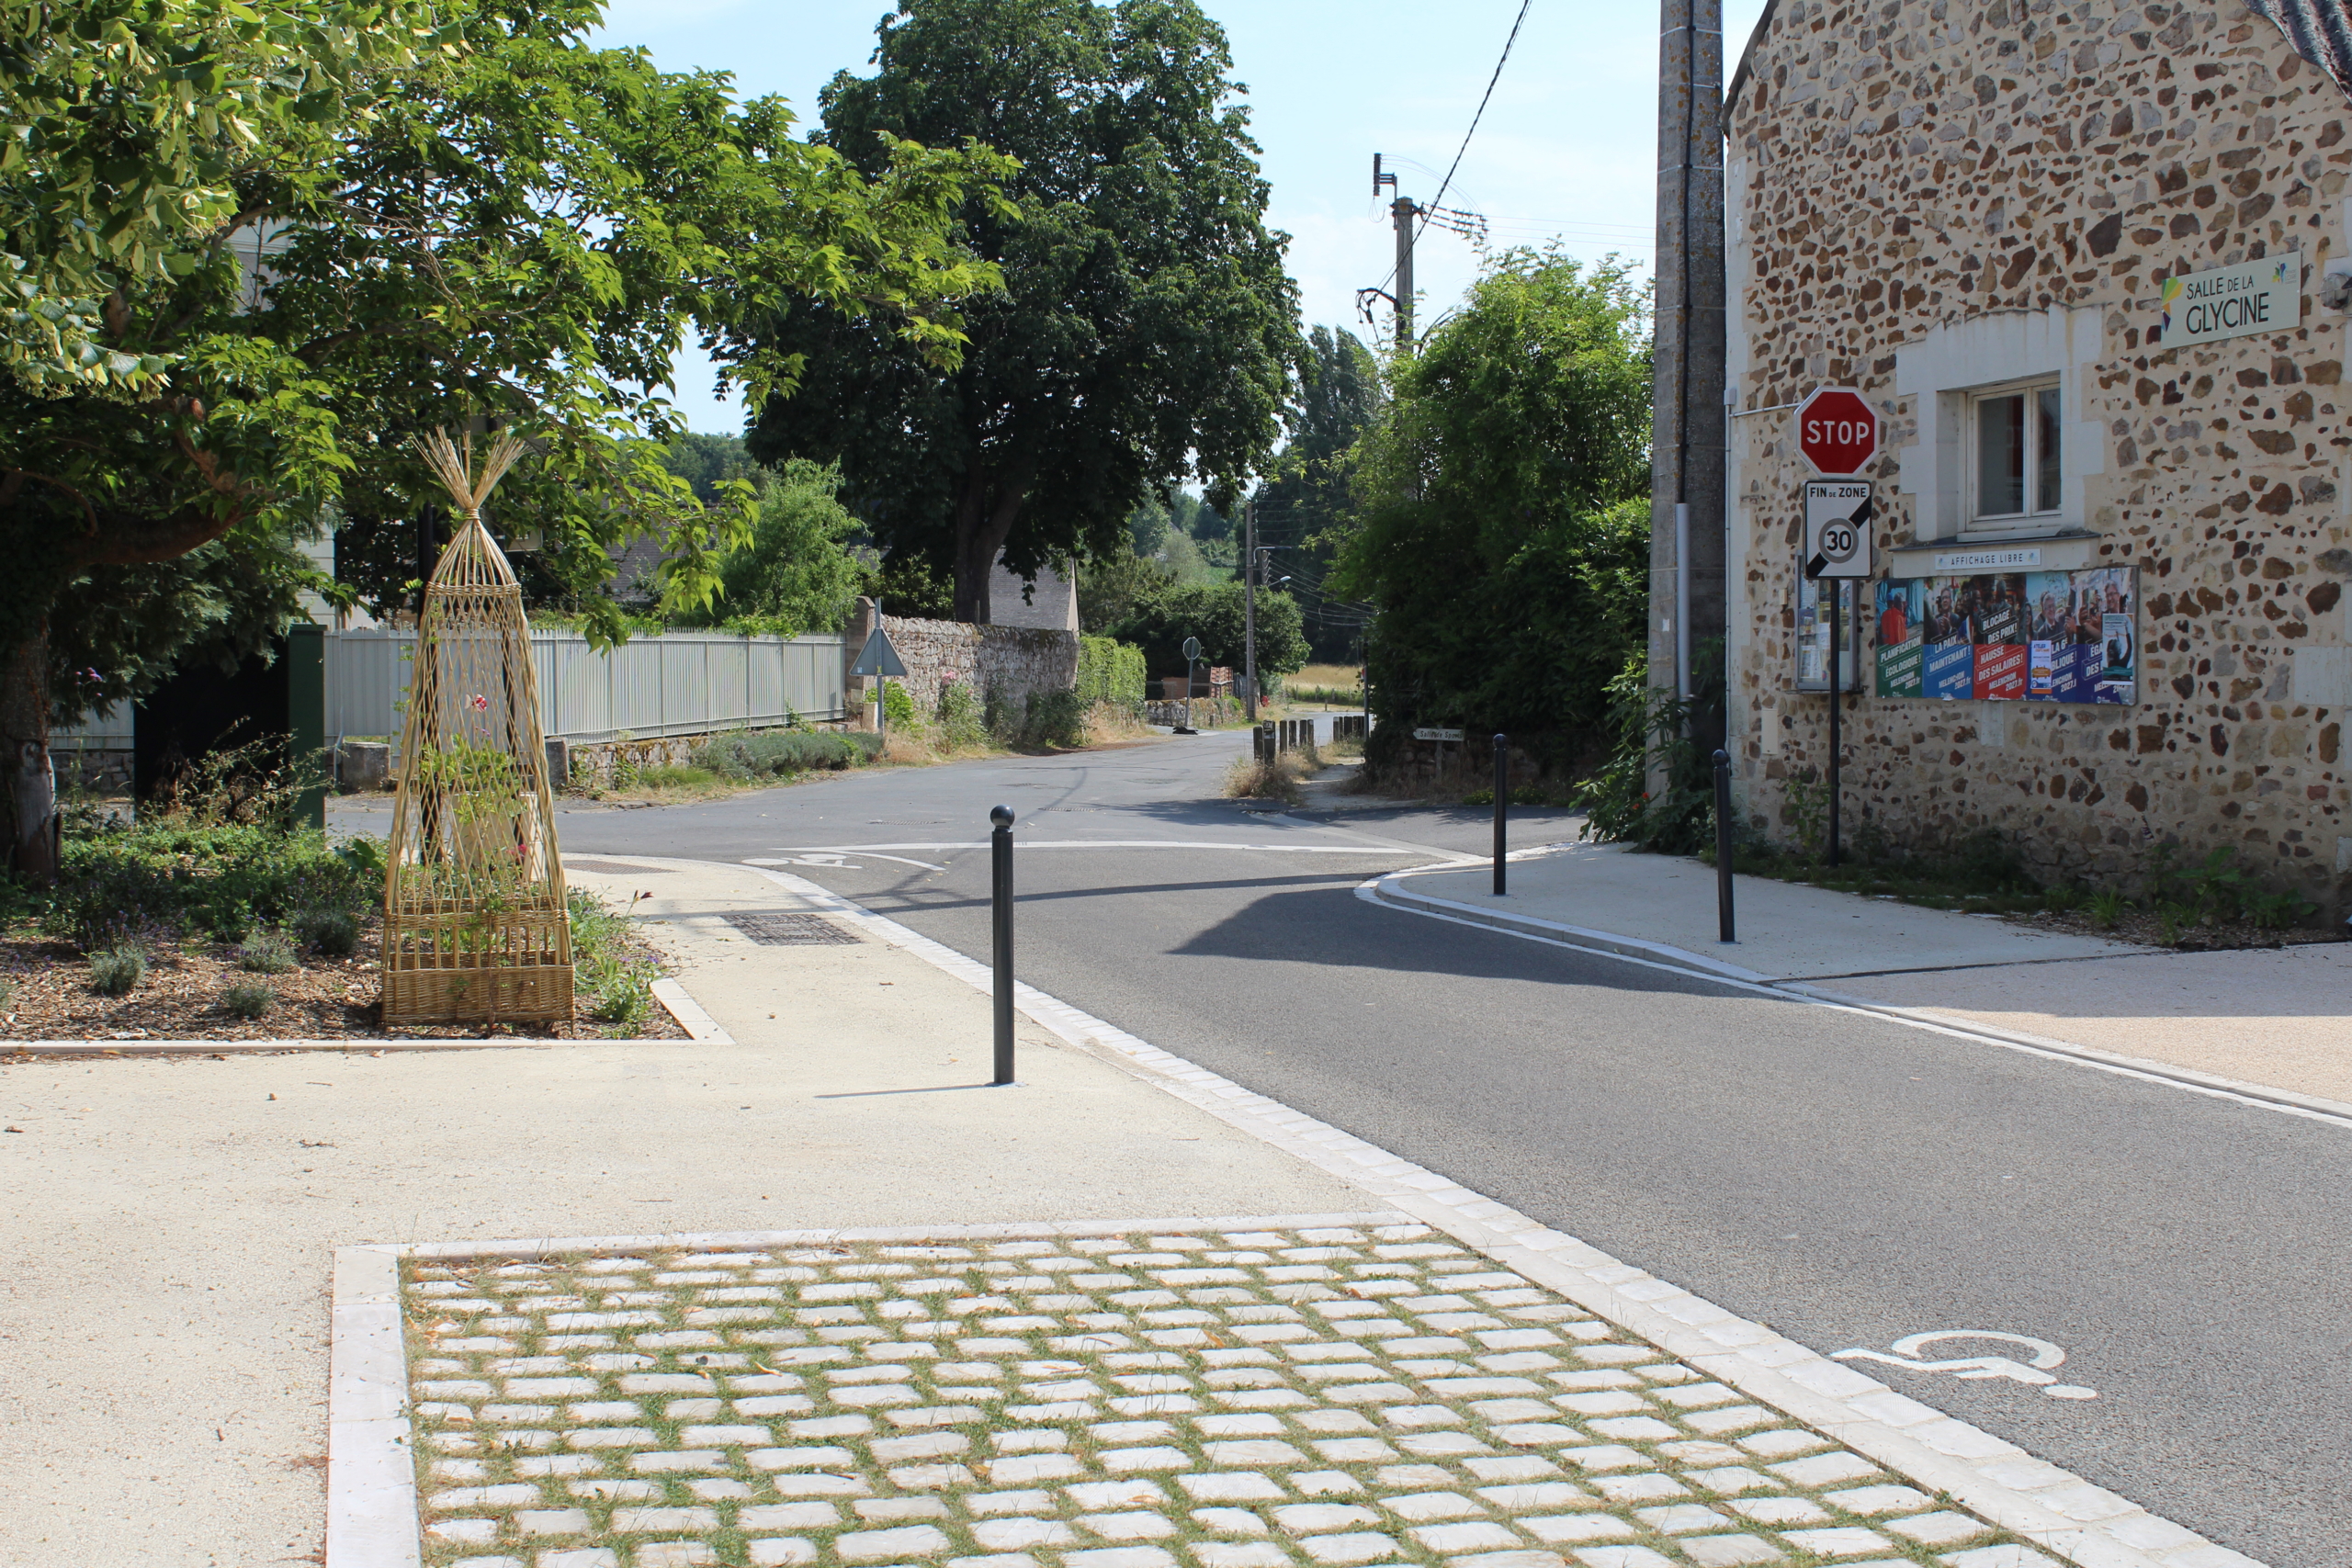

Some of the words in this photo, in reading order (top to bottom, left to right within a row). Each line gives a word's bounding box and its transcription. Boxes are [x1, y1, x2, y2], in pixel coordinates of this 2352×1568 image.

[2187, 276, 2223, 300] SALLE
[2227, 276, 2239, 293] DE
[2242, 275, 2254, 290] LA
[2186, 291, 2269, 334] GLYCINE
[1806, 420, 1870, 446] STOP
[1810, 487, 1827, 498] FIN
[1838, 487, 1867, 498] ZONE
[1826, 530, 1852, 551] 30
[1951, 555, 1996, 566] AFFICHAGE
[1999, 553, 2023, 563] LIBRE
[1983, 609, 2010, 631] BLOCAGE
[1934, 643, 1942, 654] LA
[1943, 635, 1957, 650] PAIX
[1987, 631, 1999, 645] DES
[1880, 636, 1921, 663] PLANIFICATION
[1980, 645, 2005, 665] HAUSSE
[1978, 667, 1991, 682] DES
